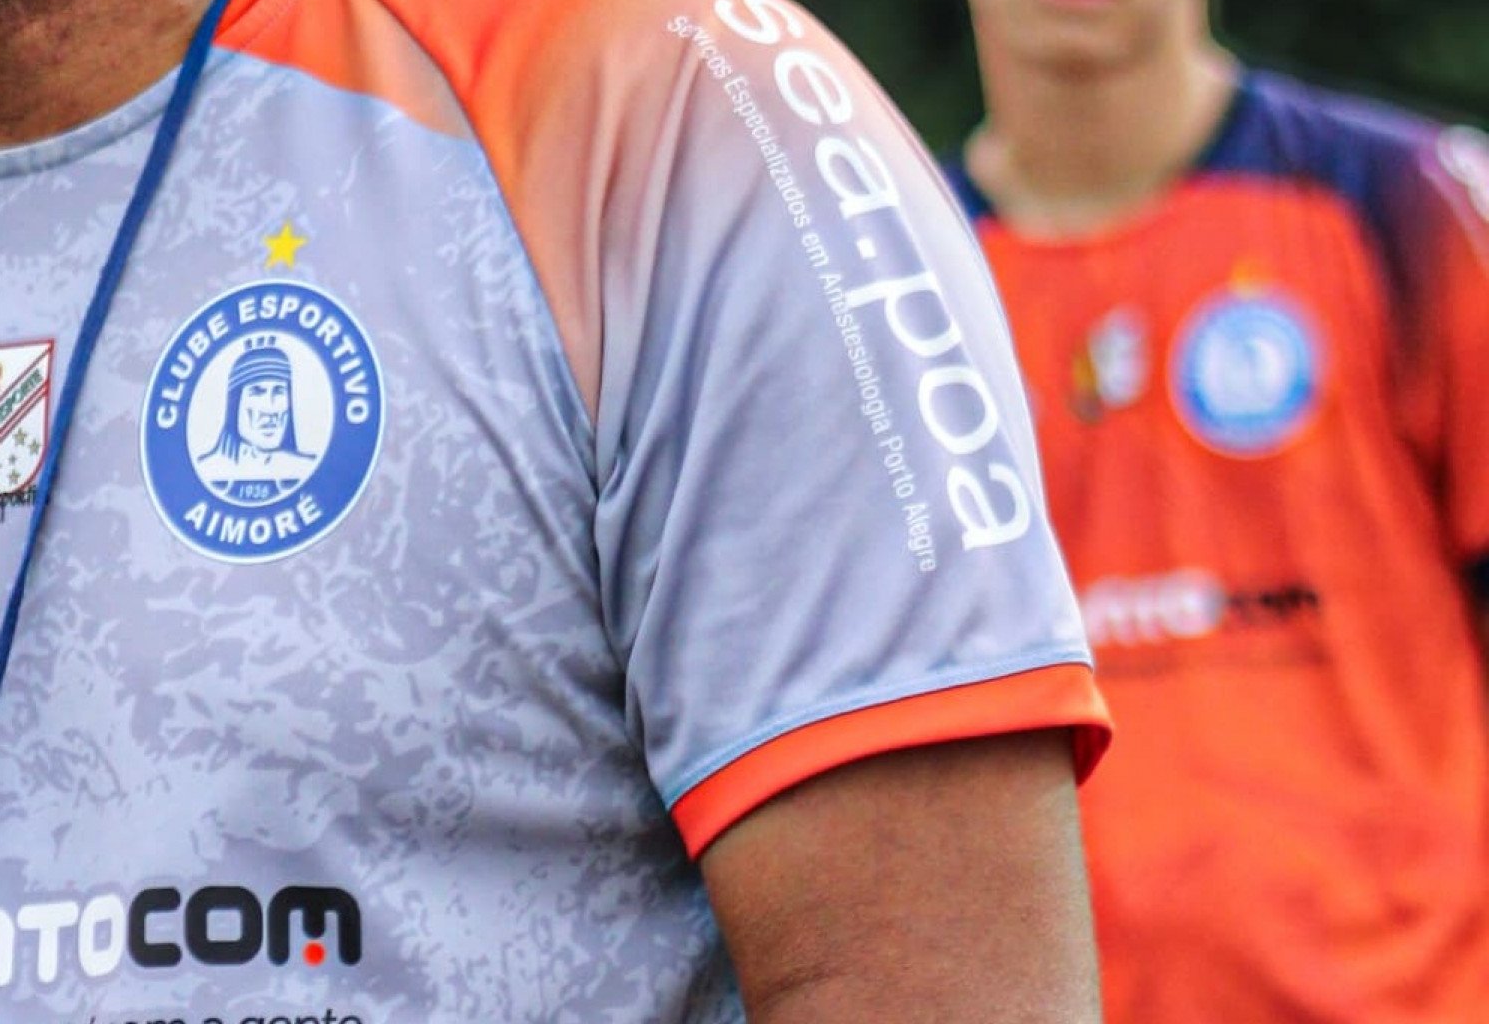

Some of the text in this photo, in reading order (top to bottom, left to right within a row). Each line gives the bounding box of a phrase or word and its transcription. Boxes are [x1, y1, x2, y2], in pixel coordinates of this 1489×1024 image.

[156, 295, 370, 429] CLUBE ESPORTIVO
[724, 75, 810, 229] Especializados
[801, 232, 830, 268] em
[881, 435, 916, 499] Porto
[903, 502, 937, 573] Alegre
[183, 494, 323, 545] AIMORÉ
